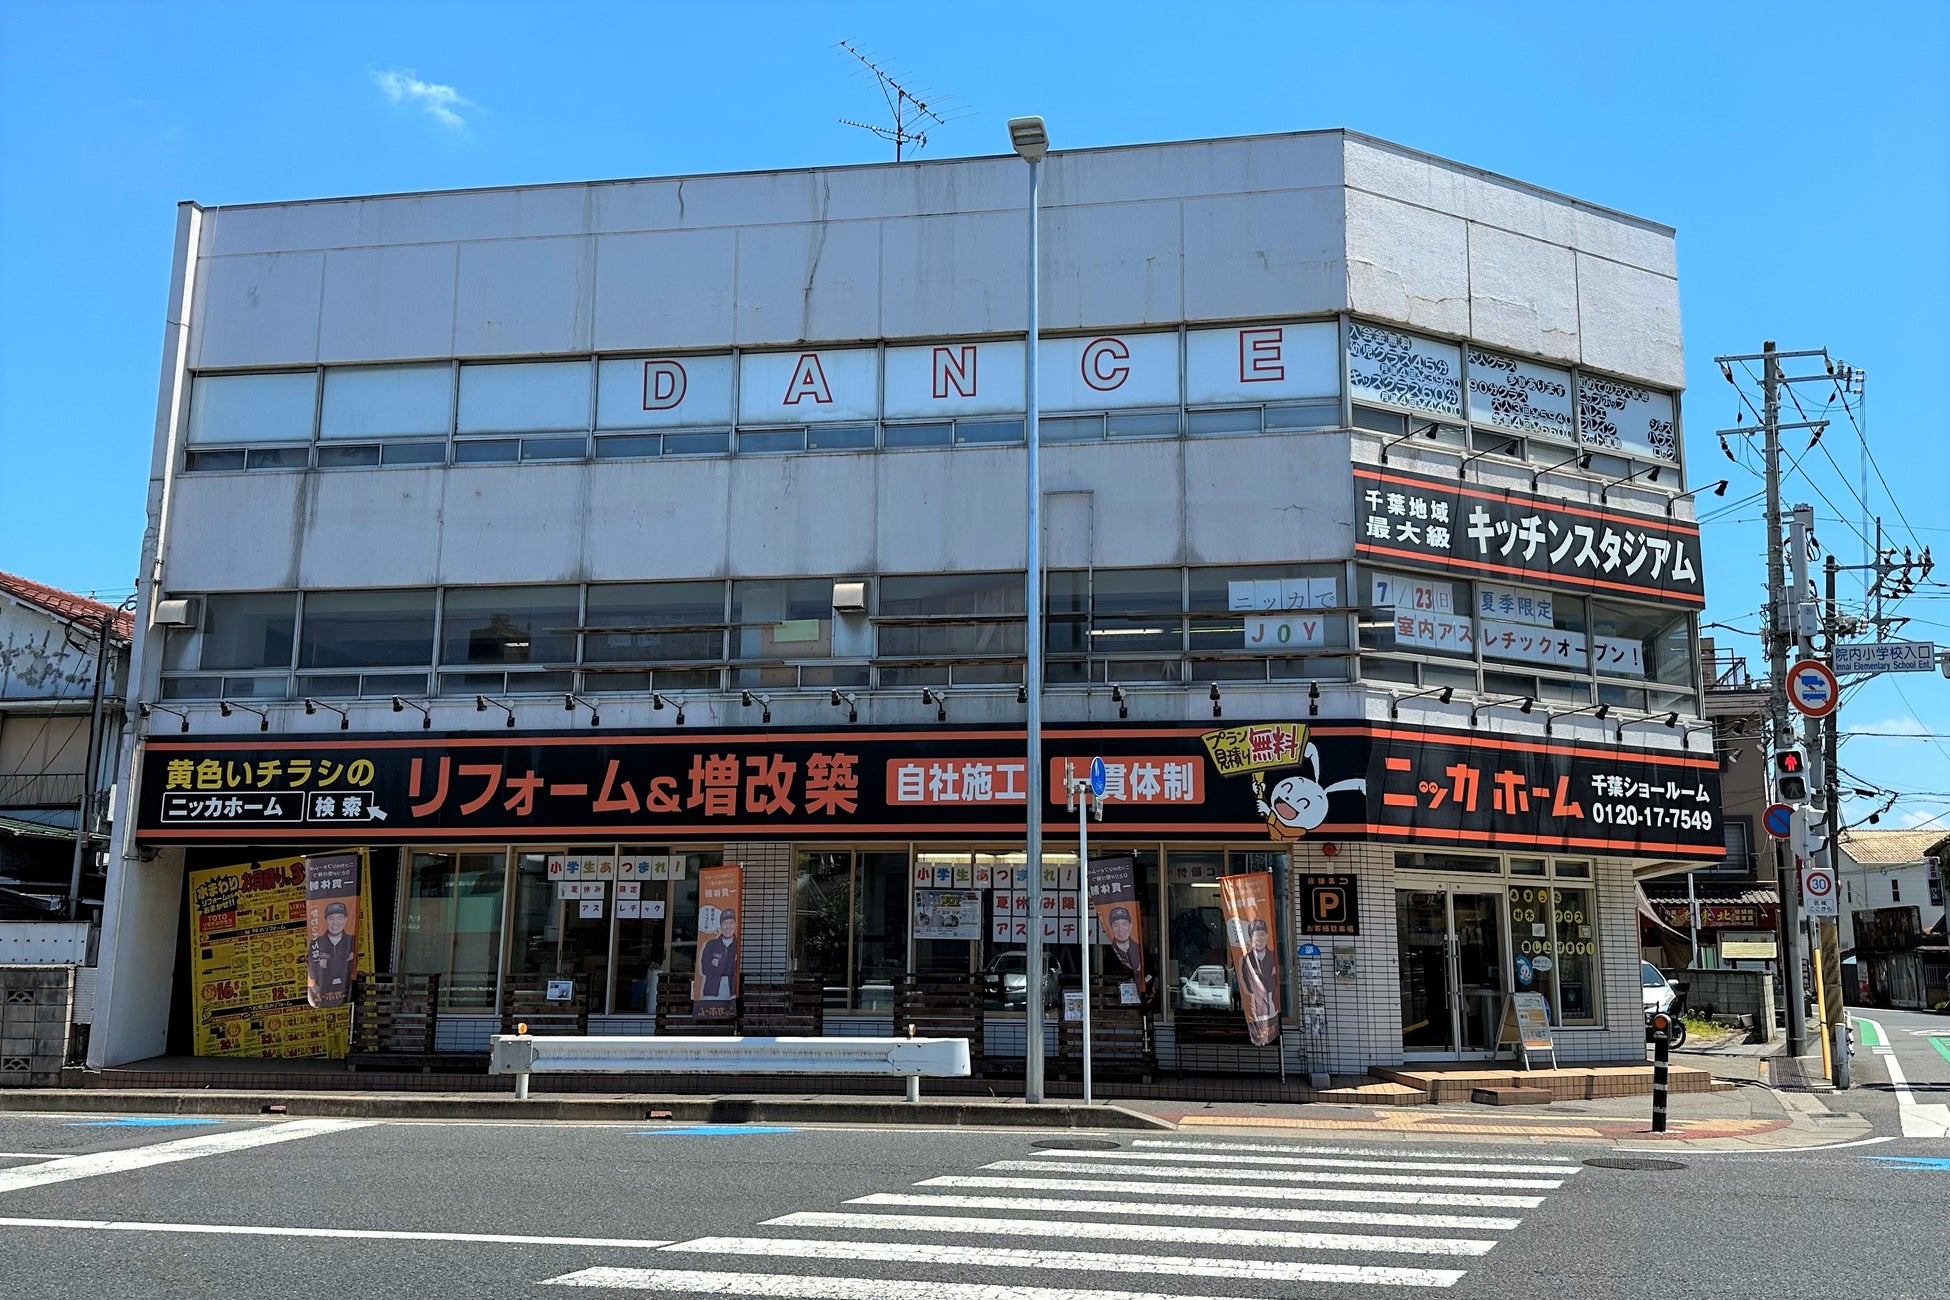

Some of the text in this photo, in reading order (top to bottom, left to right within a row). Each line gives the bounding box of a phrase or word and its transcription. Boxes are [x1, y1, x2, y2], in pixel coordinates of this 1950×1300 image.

[642, 327, 1286, 412] DANCE
[1350, 341, 1449, 375] 幼児クラス45分
[1468, 351, 1517, 373] 大人クラス
[1469, 379, 1528, 403] 90分クラス
[1648, 431, 1674, 447] ハウス
[1653, 446, 1675, 460] ロック
[1364, 490, 1449, 524] 千葉地域
[1366, 516, 1451, 550] 最大級
[1467, 506, 1697, 584] キッチンスタジアム
[1234, 591, 1336, 609] ニッカで
[1480, 589, 1553, 623] 夏季限定
[1251, 621, 1317, 643] JOY
[1836, 646, 1930, 661] 院内小学校入口
[1836, 663, 1850, 671] Innai
[1854, 662, 1890, 671] Elementary
[1893, 661, 1916, 669] School
[1206, 731, 1247, 749] プラン
[1249, 724, 1298, 763] 無料
[1214, 747, 1250, 770] 見積り
[166, 758, 375, 790] 黄色いチラシの
[409, 753, 859, 818] リフォーム&増改築
[898, 763, 1026, 801] 自社施工
[1384, 757, 1584, 819] ニッカホーム
[1591, 775, 1710, 803] 千葉ショールーム
[169, 796, 363, 818] ニッカホーム 検索
[1592, 806, 1712, 831] 0120-17-7549
[1812, 879, 1826, 890] 30
[1320, 892, 1338, 917] P
[1513, 909, 1583, 924] 材木 クロス
